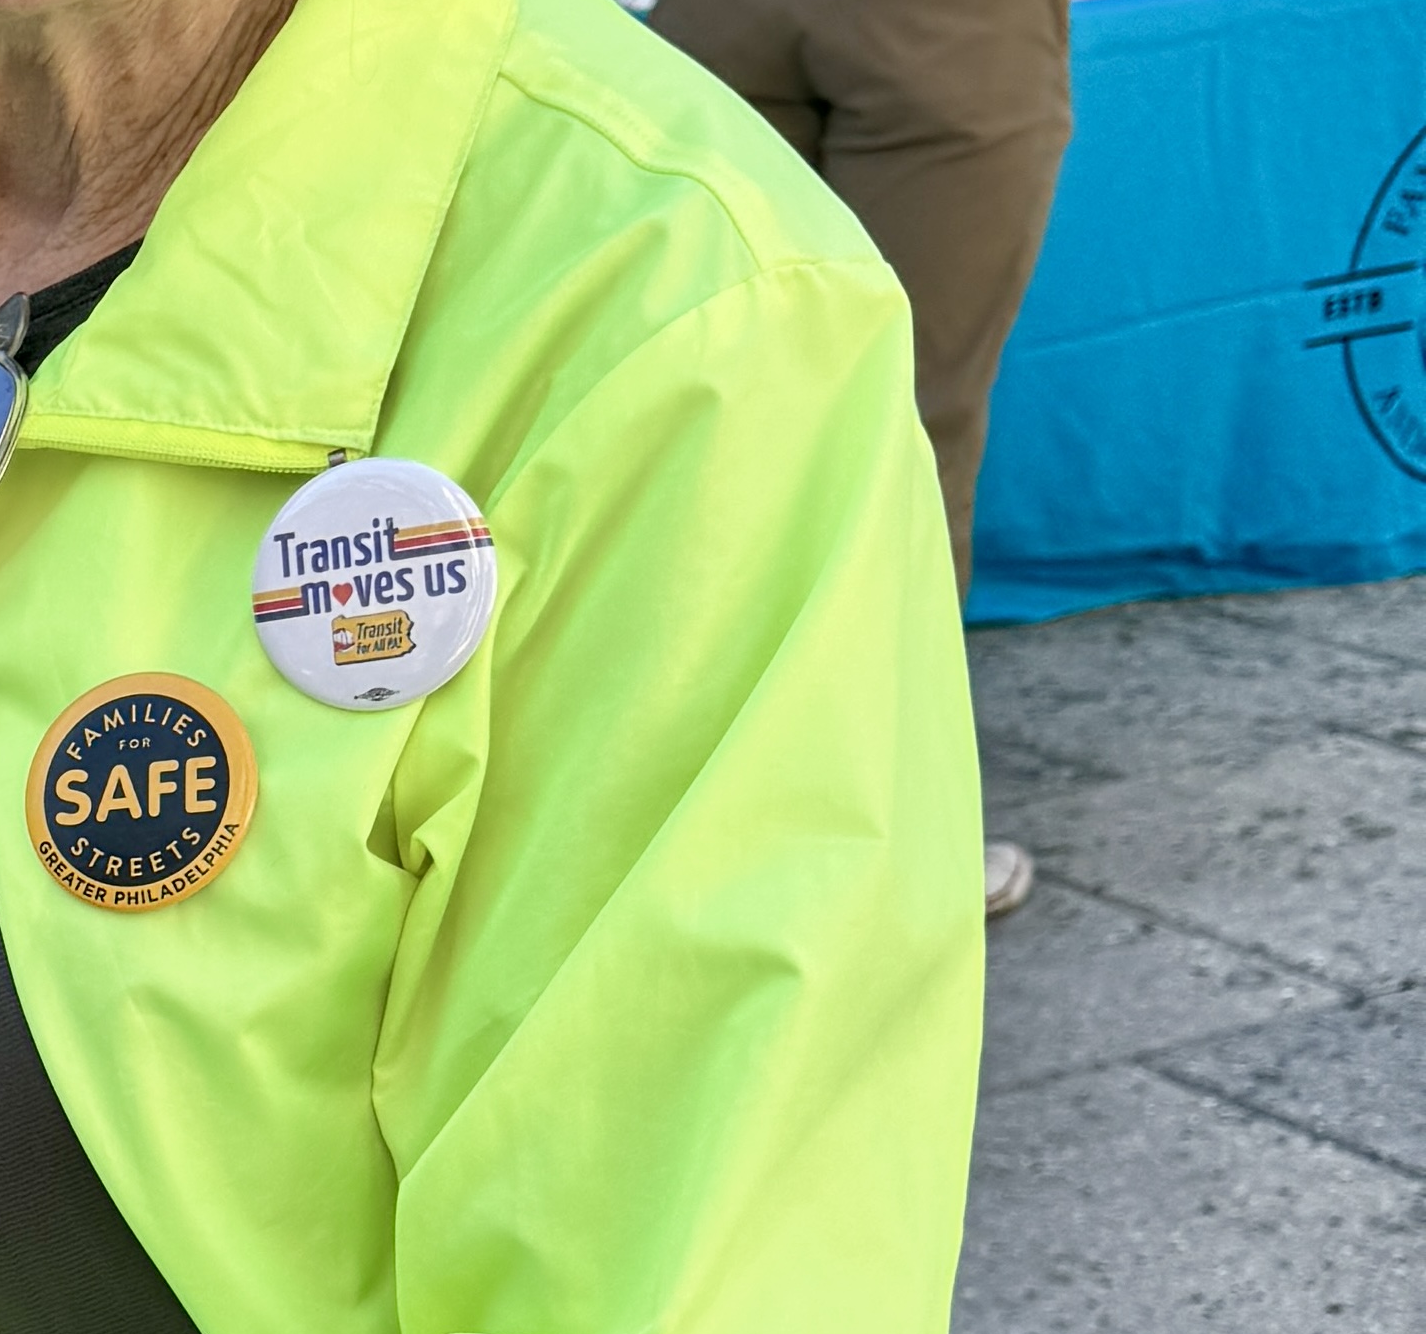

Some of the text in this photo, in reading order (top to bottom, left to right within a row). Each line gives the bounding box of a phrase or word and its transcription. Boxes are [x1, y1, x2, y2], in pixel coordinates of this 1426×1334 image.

[273, 517, 399, 578] Transit
[424, 559, 467, 597] us
[356, 617, 402, 640] Transit
[66, 703, 207, 760] FAMILIES
[119, 737, 152, 750] FOR
[55, 756, 217, 826] SAFE
[38, 822, 240, 905] GREATER PHILADELPHIA
[70, 827, 201, 877] STREETS
